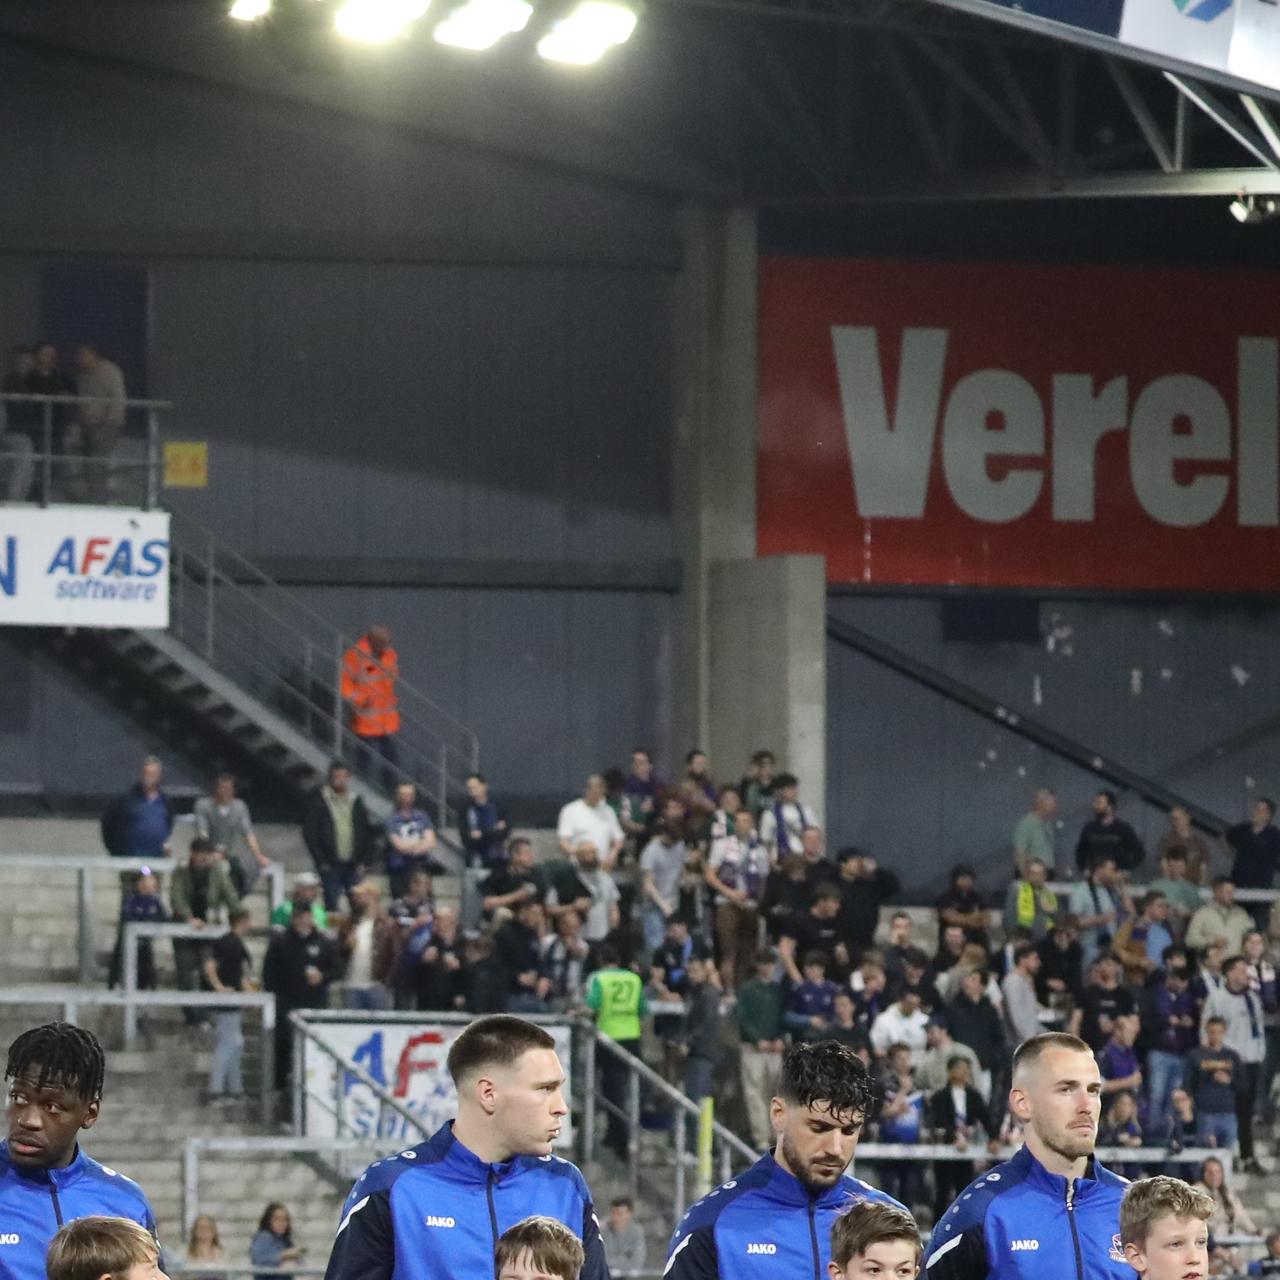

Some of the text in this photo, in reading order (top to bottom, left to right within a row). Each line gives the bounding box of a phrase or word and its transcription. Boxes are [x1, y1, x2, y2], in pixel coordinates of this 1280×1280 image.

[831, 325, 1279, 528] Verel
[47, 537, 168, 577] AFAS
[56, 575, 157, 601] software
[426, 1215, 456, 1228] JAKO
[747, 1243, 777, 1254] JAKO
[1011, 1239, 1039, 1251] JAKO
